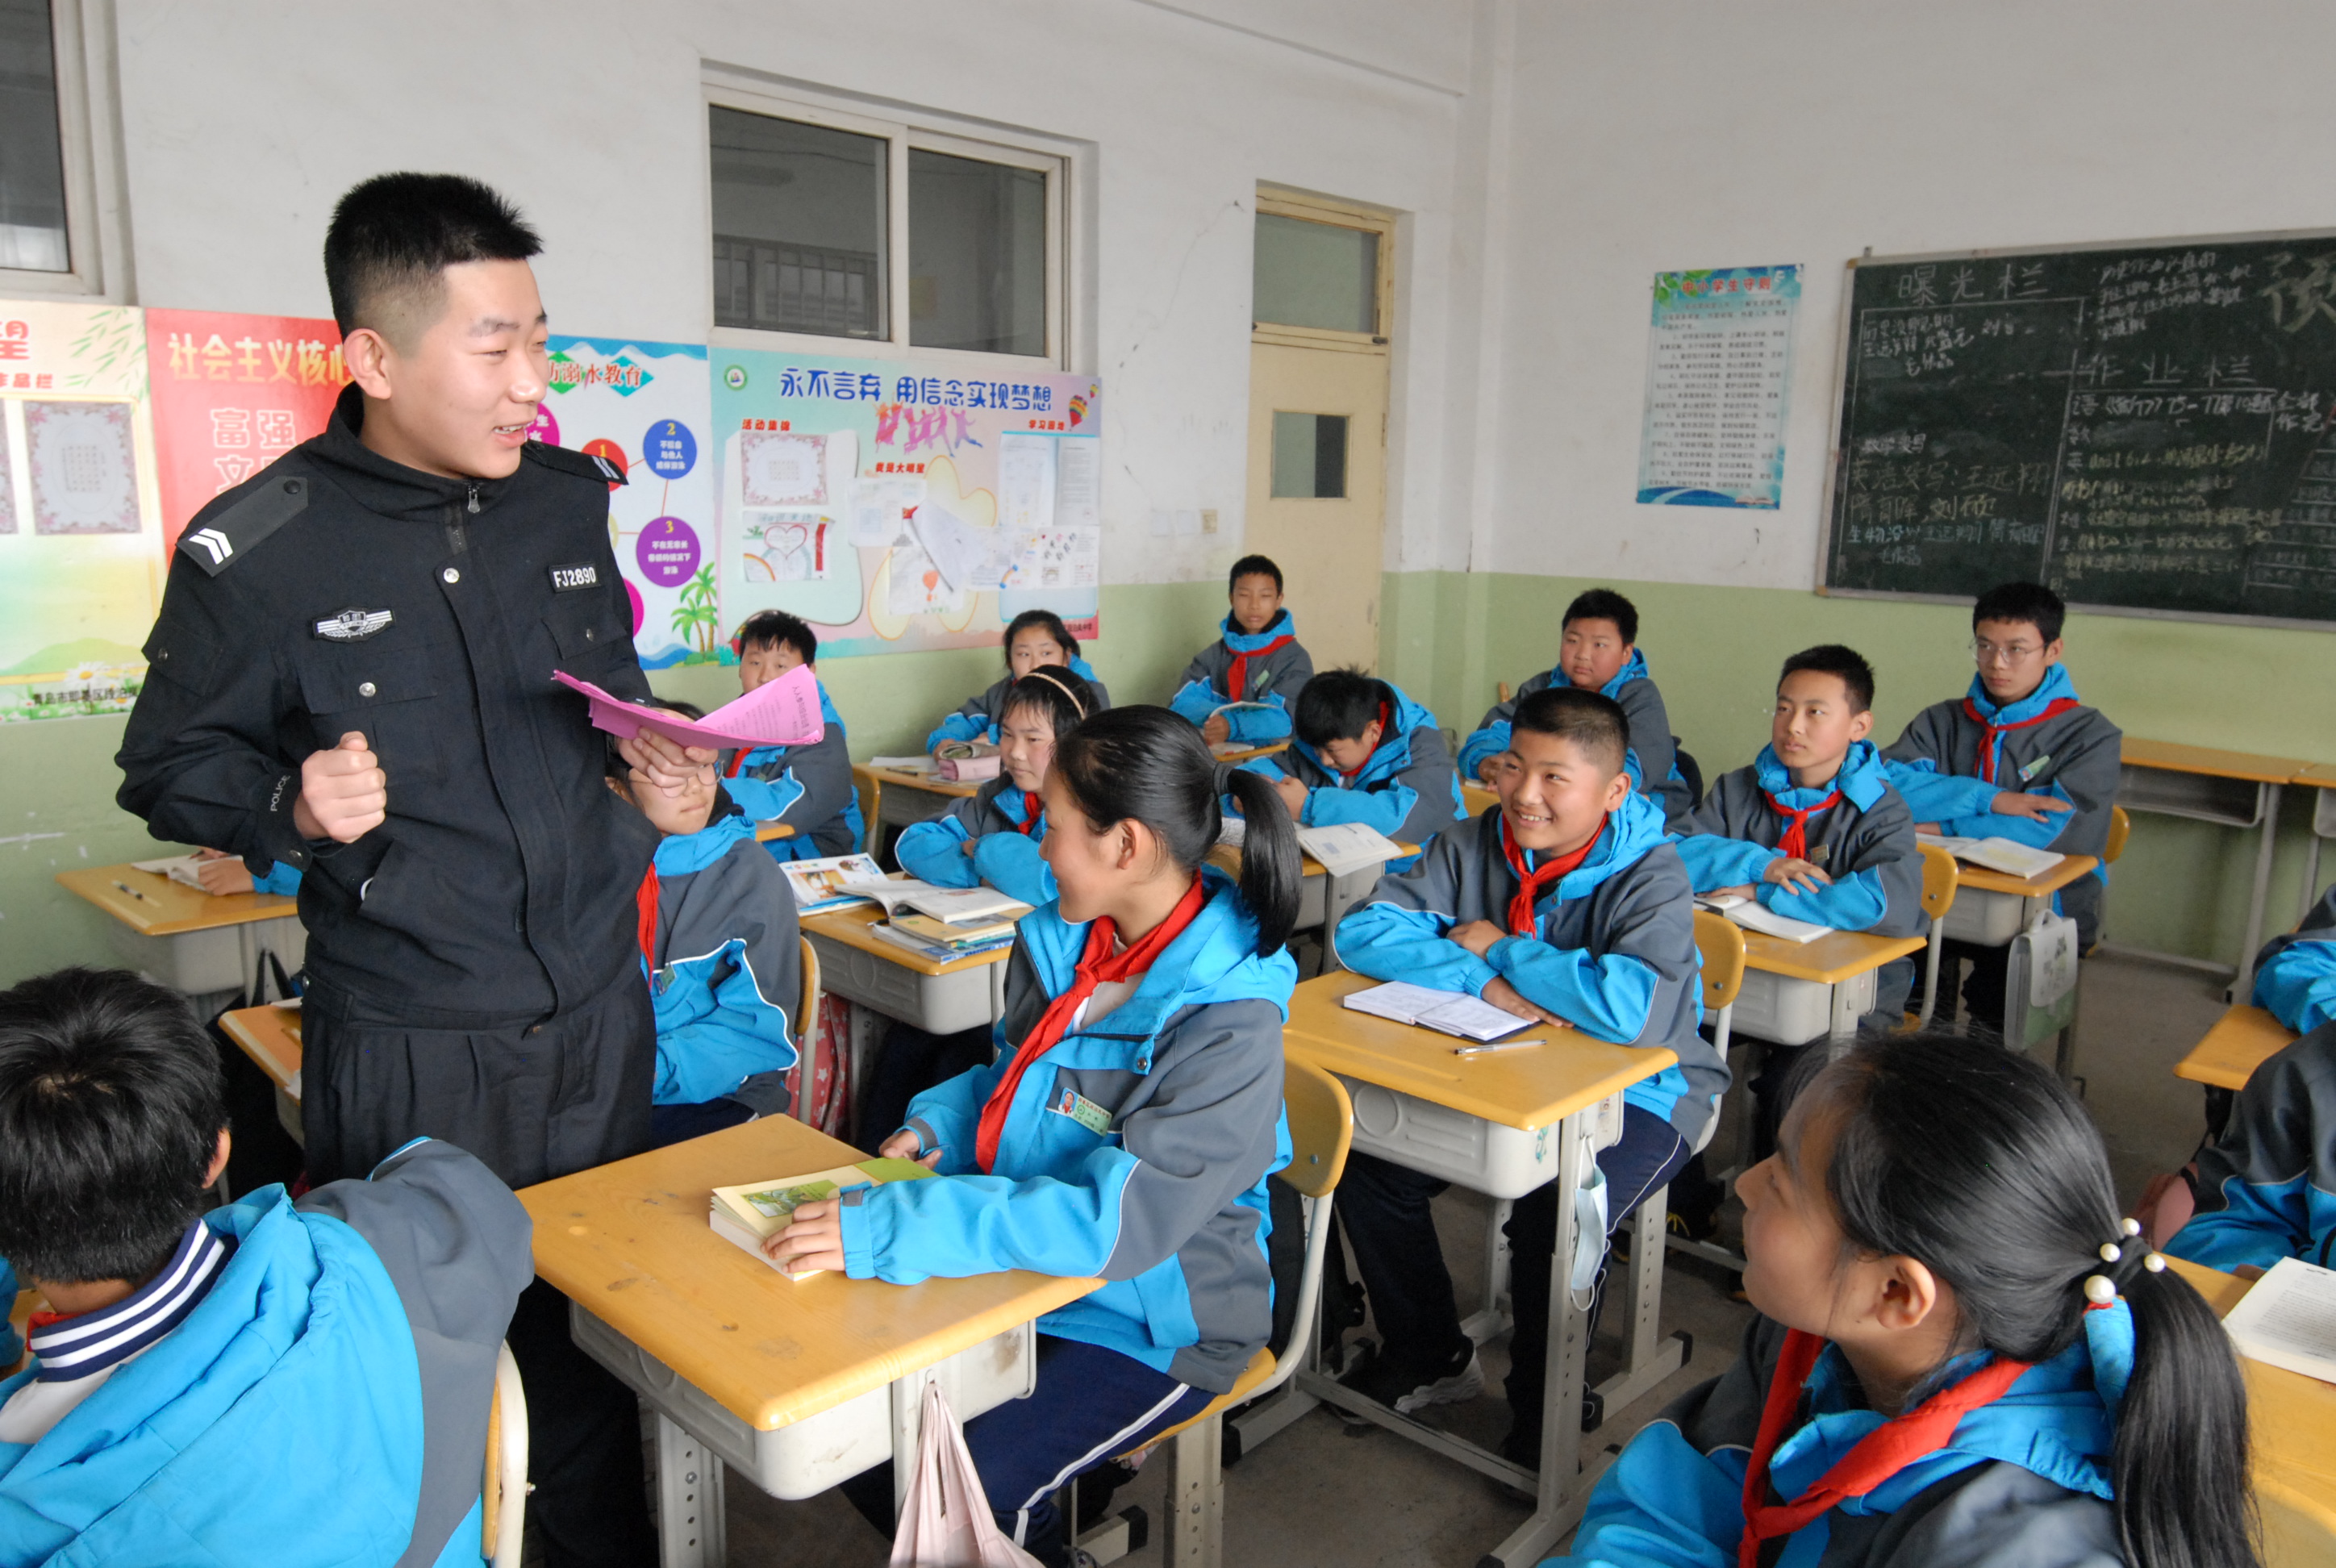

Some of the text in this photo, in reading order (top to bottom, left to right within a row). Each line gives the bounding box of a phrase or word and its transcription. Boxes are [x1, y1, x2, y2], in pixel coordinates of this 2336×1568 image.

[1683, 277, 1771, 293] 中小学生守则
[1898, 263, 2049, 307] 曝光栏
[168, 332, 353, 386] 社会主义核心
[780, 368, 1052, 411] 永不言弃 用信念实现梦想
[211, 407, 298, 449] 富强
[667, 423, 676, 436] 2
[741, 419, 791, 432] 活动集锦
[1028, 419, 1065, 431] 学习园地
[599, 444, 607, 457] 1
[214, 454, 282, 494] 文
[875, 461, 926, 474] 我是大明星
[665, 520, 674, 534] 3
[553, 566, 596, 588] FJ2890
[270, 775, 290, 811] POLICE
